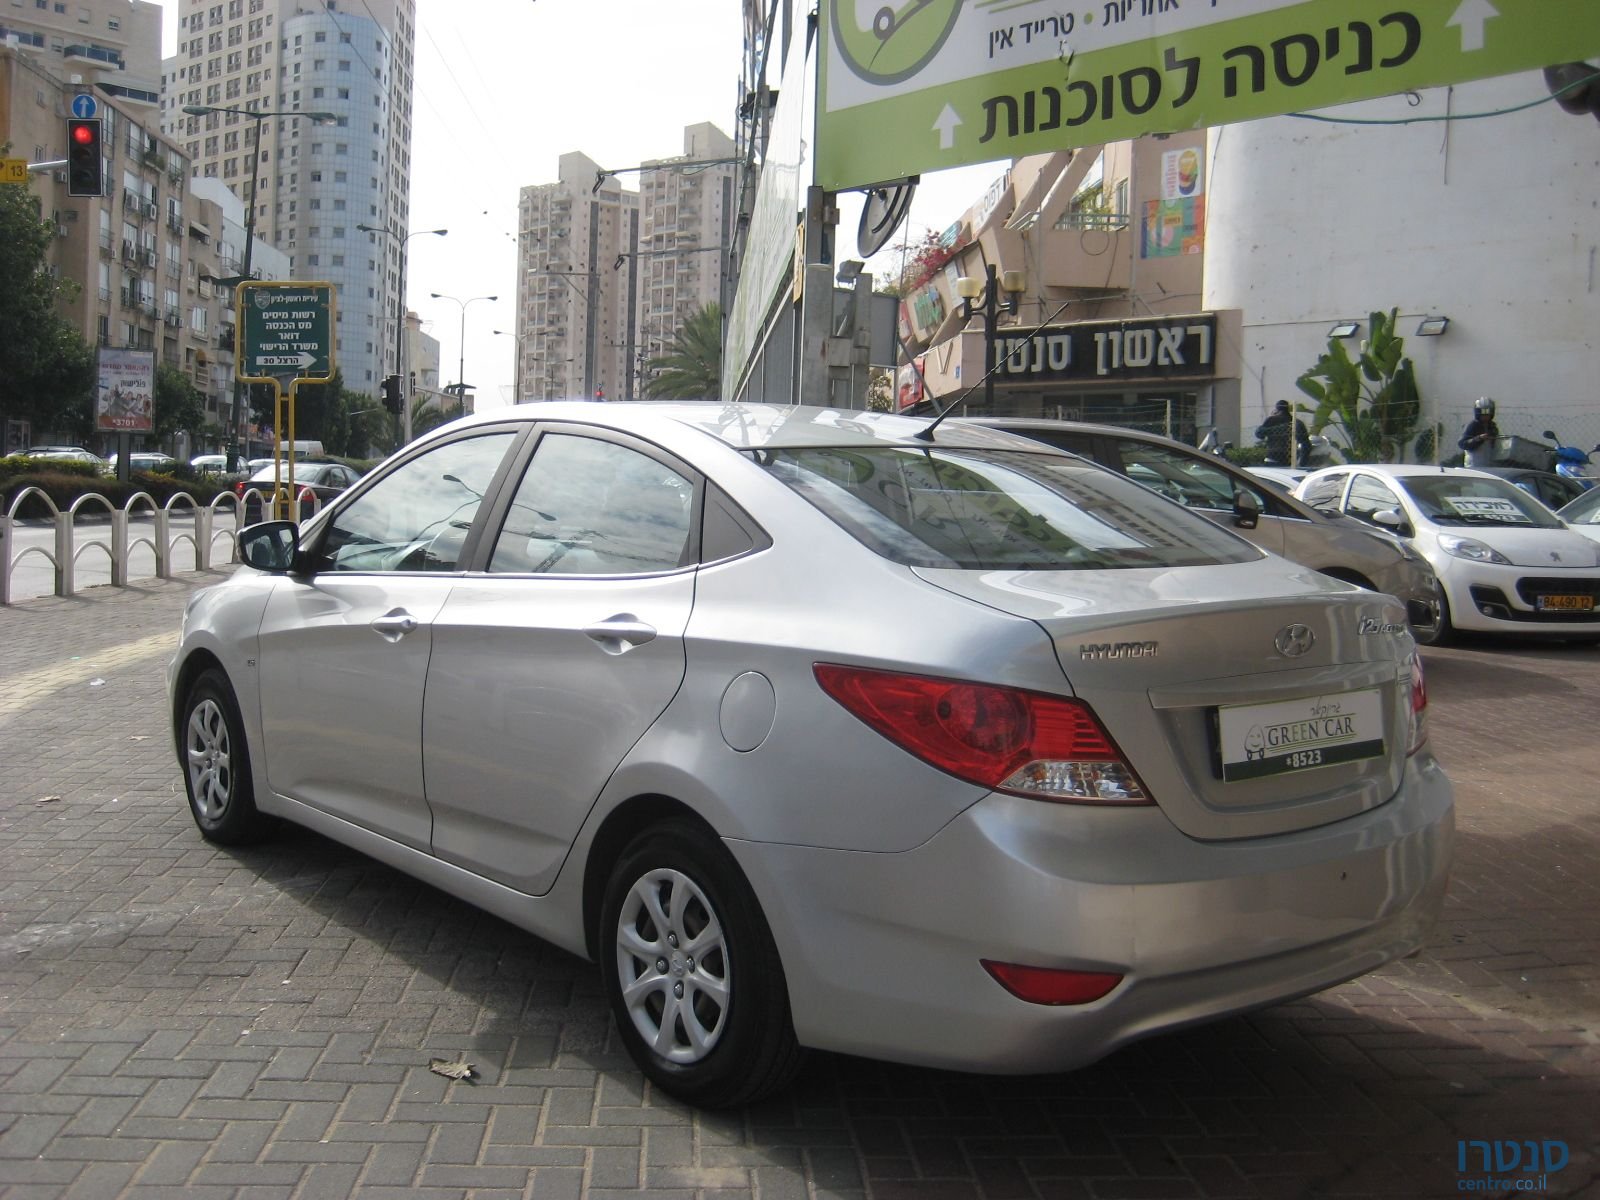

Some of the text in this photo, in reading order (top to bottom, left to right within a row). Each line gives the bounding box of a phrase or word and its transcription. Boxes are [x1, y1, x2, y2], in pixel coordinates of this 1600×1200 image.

[988, 12, 1075, 58] טרייד אין
[979, 11, 1422, 143] כניסה לסוכנות
[10, 165, 23, 177] 13
[262, 311, 316, 319] רשות מיסים
[265, 321, 312, 330] מס הכנסה
[278, 332, 300, 340] דואר
[259, 342, 318, 351] משרד הרישוי
[1094, 324, 1211, 375] ראשון
[277, 355, 299, 365] הרצל
[1080, 641, 1159, 660] HYUNDAI
[1267, 716, 1354, 746] GREEN CAR
